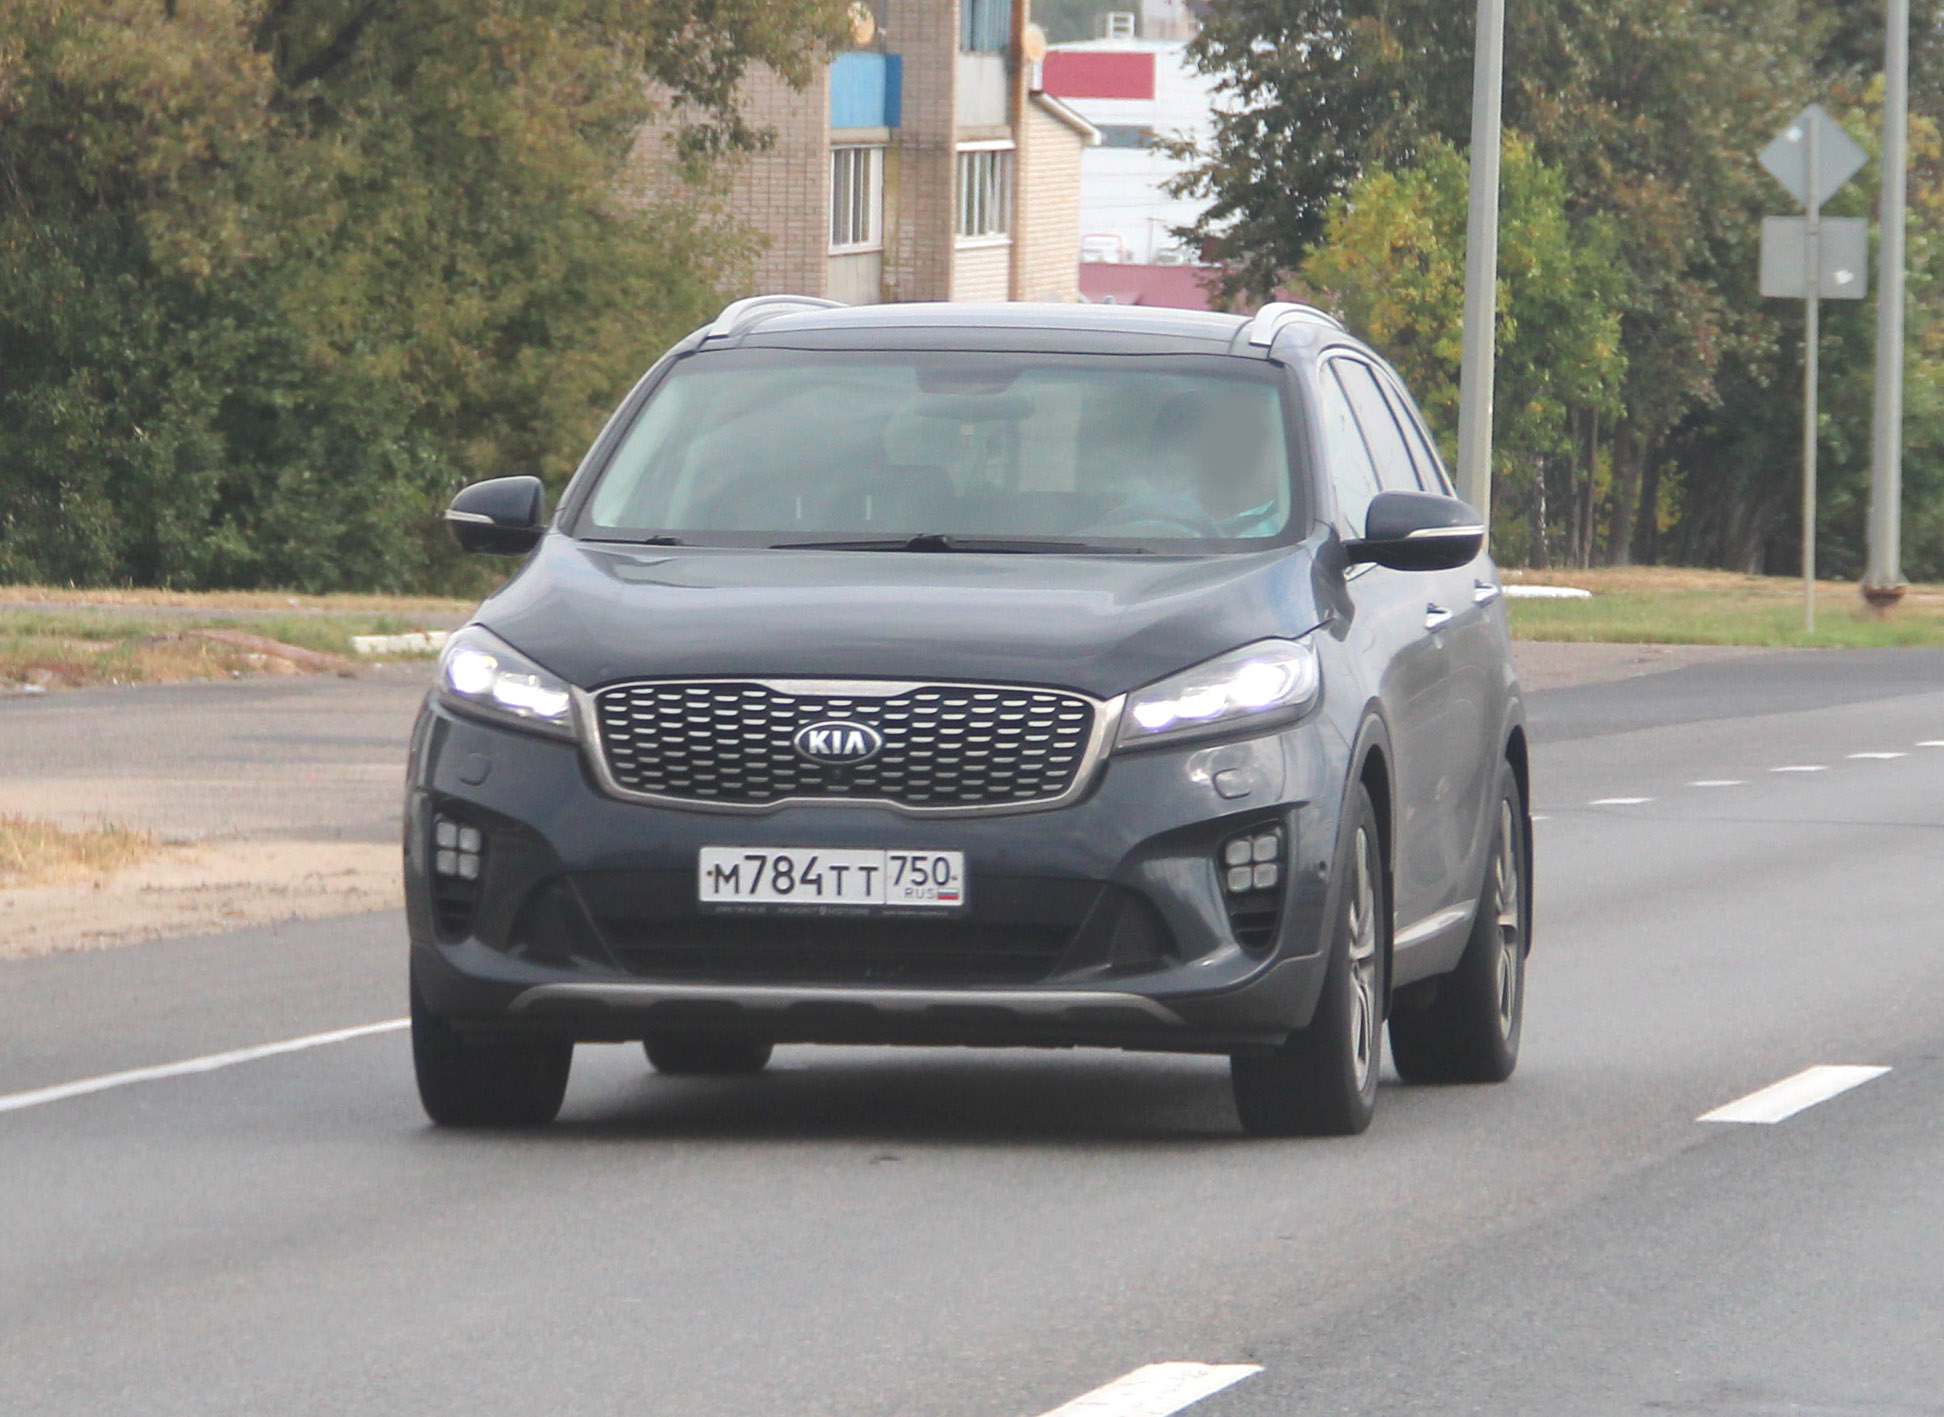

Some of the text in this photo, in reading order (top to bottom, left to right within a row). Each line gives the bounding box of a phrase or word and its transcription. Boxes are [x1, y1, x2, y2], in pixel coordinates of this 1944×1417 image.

[808, 729, 867, 755] KIA
[890, 855, 950, 886] 750
[904, 887, 936, 899] RUS
